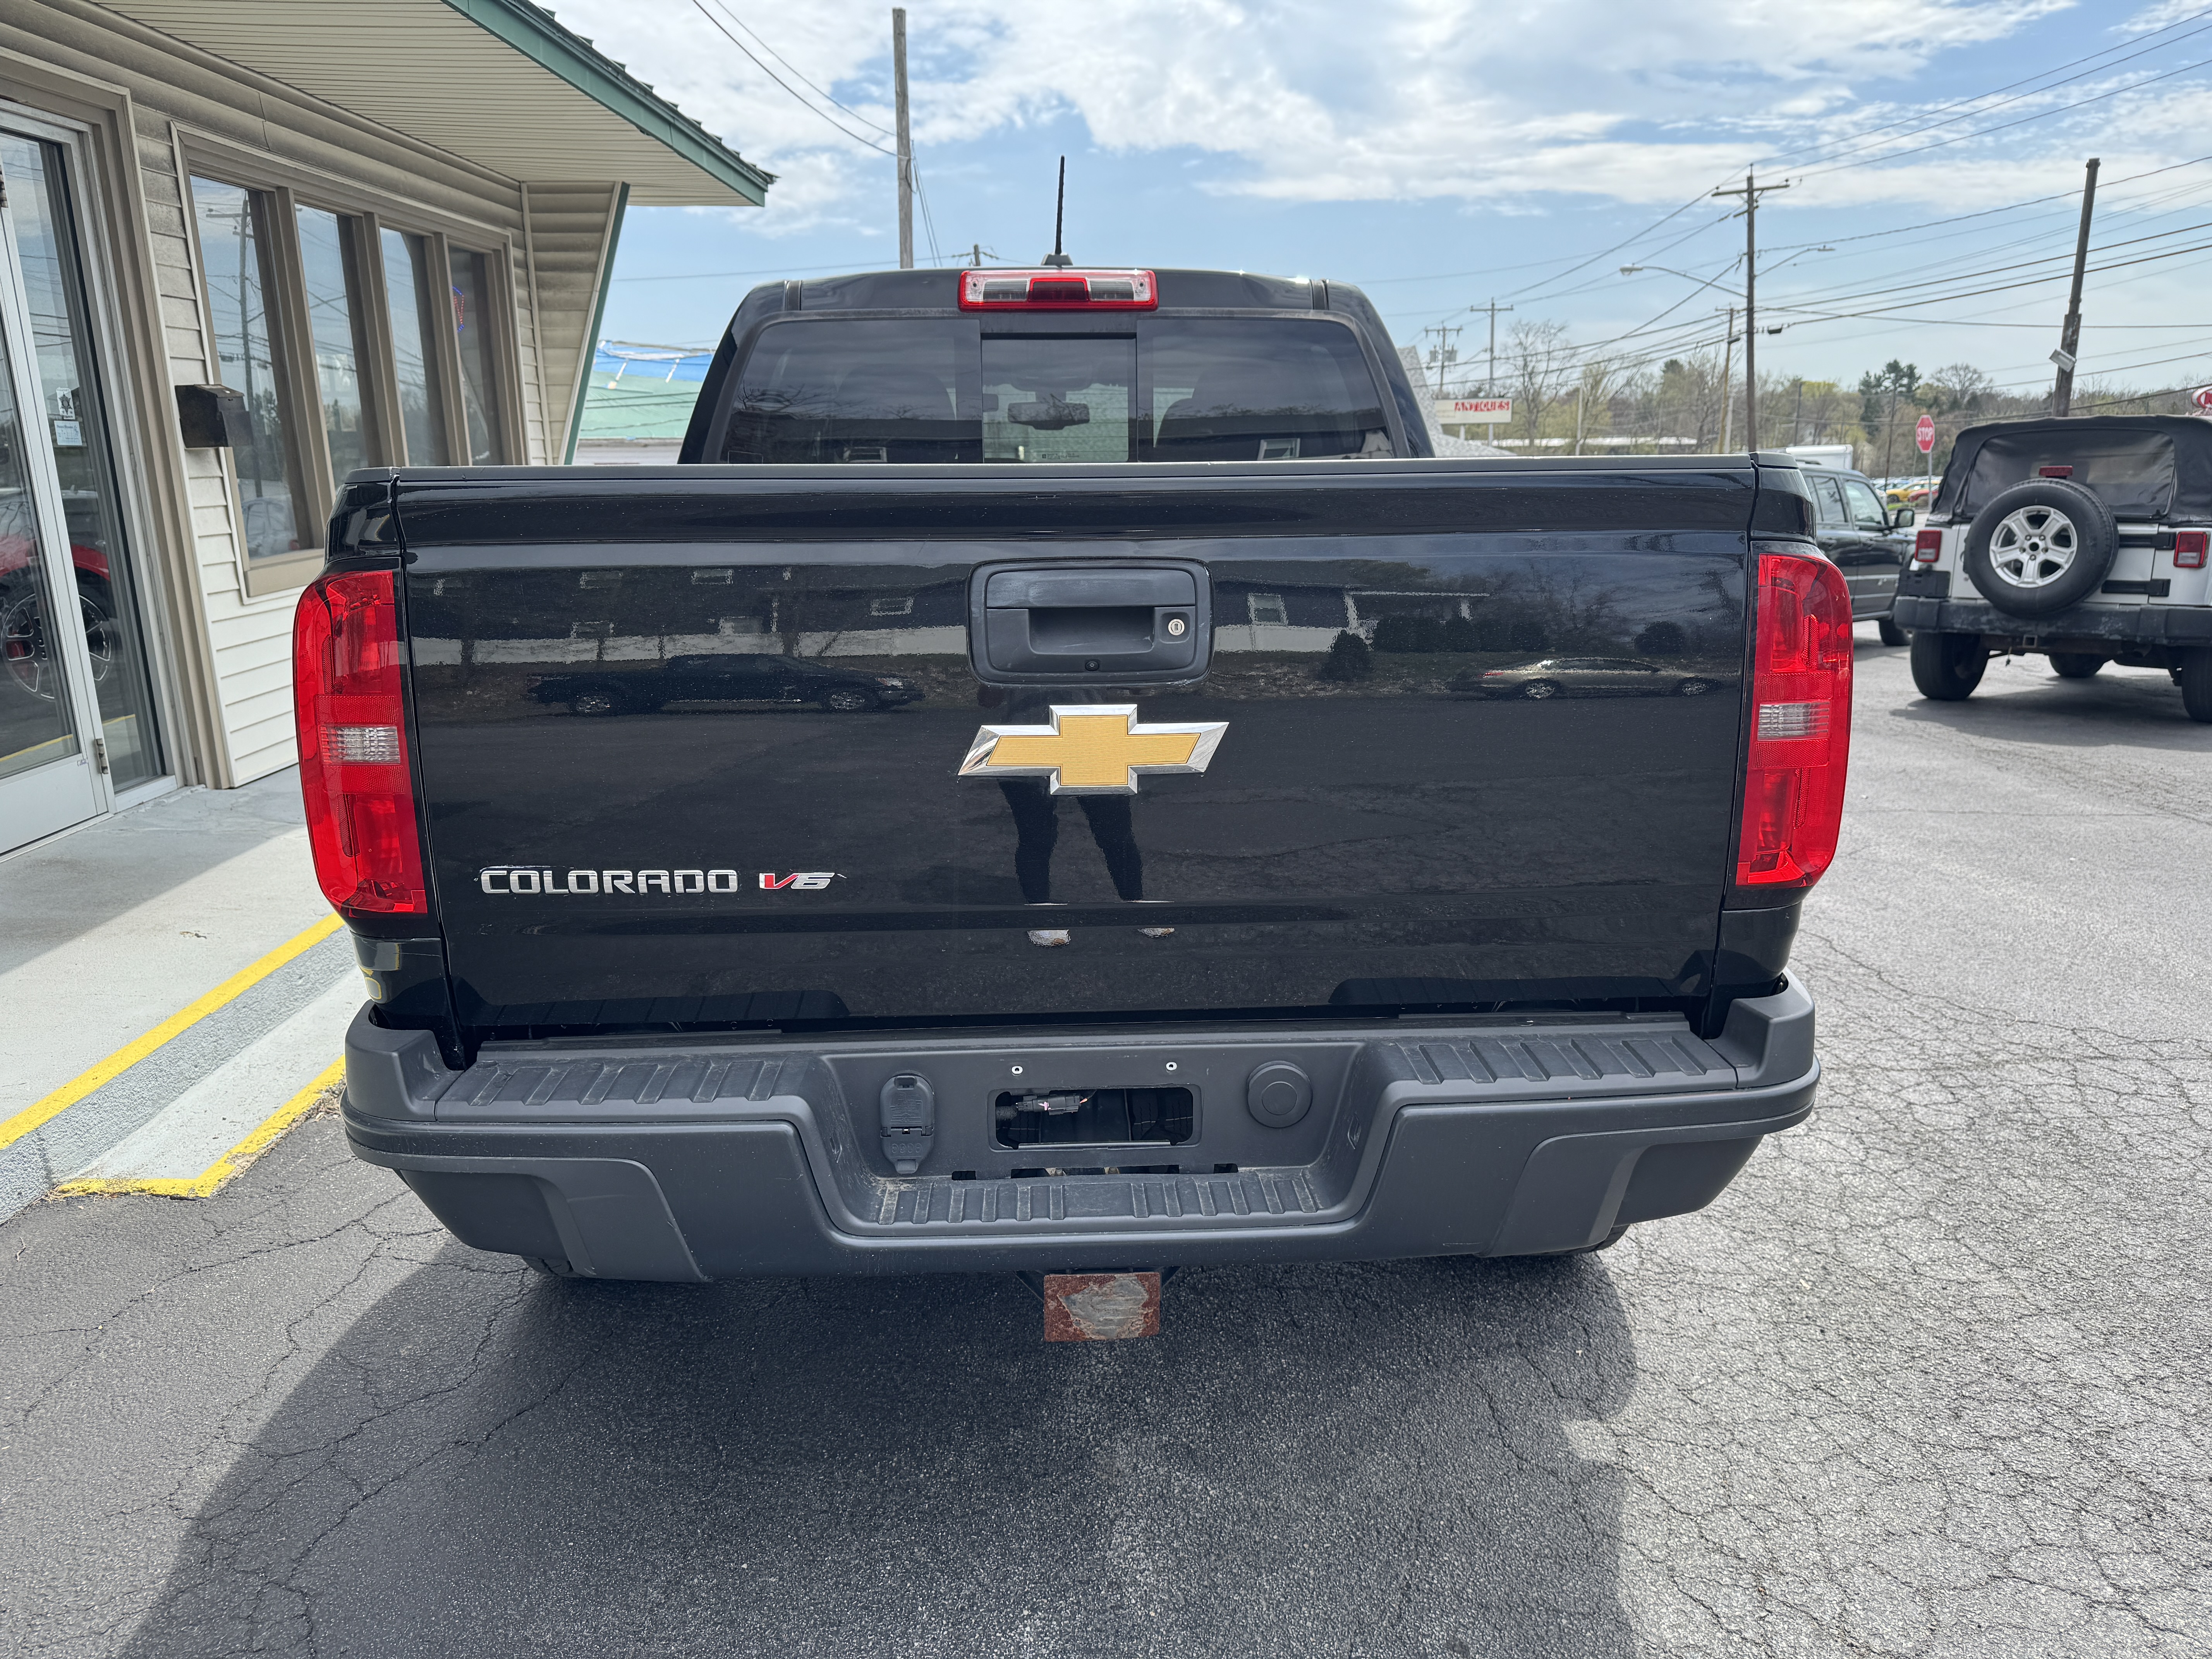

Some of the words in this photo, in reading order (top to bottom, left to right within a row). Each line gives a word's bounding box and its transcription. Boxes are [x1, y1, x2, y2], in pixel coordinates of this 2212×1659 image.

[1454, 400, 1510, 412] ANTIQUES
[1917, 427, 1933, 441] STOP
[481, 870, 738, 894] COLORADO
[759, 872, 835, 890] V6
